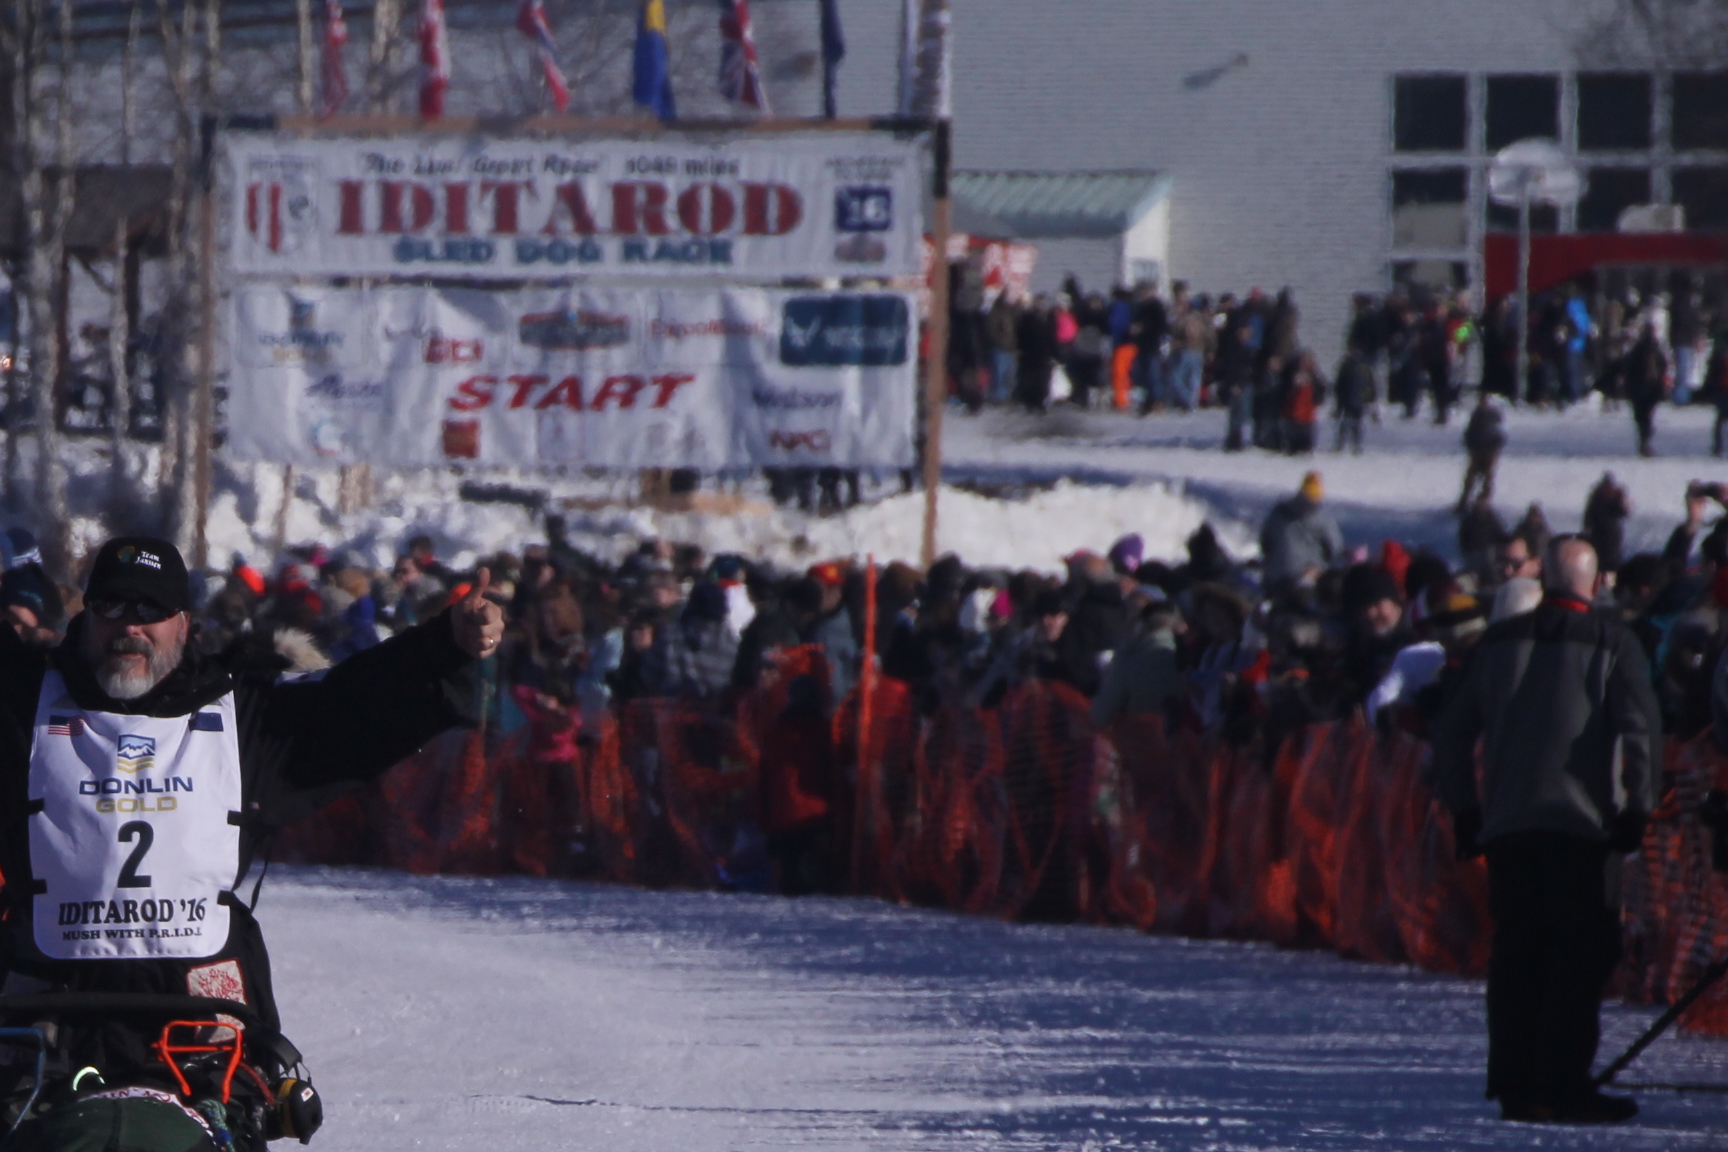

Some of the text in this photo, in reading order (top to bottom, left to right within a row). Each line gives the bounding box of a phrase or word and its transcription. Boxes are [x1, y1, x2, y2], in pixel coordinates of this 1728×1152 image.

[335, 179, 803, 236] IDITAROD
[393, 235, 734, 264] SLED DOG RACE
[448, 372, 696, 412] START
[78, 776, 194, 795] DONLIN
[95, 796, 178, 813] GOLD
[117, 820, 154, 889] 2
[58, 897, 207, 926] IDITAROD '16
[62, 929, 101, 941] MUSH
[104, 928, 145, 940] WITH
